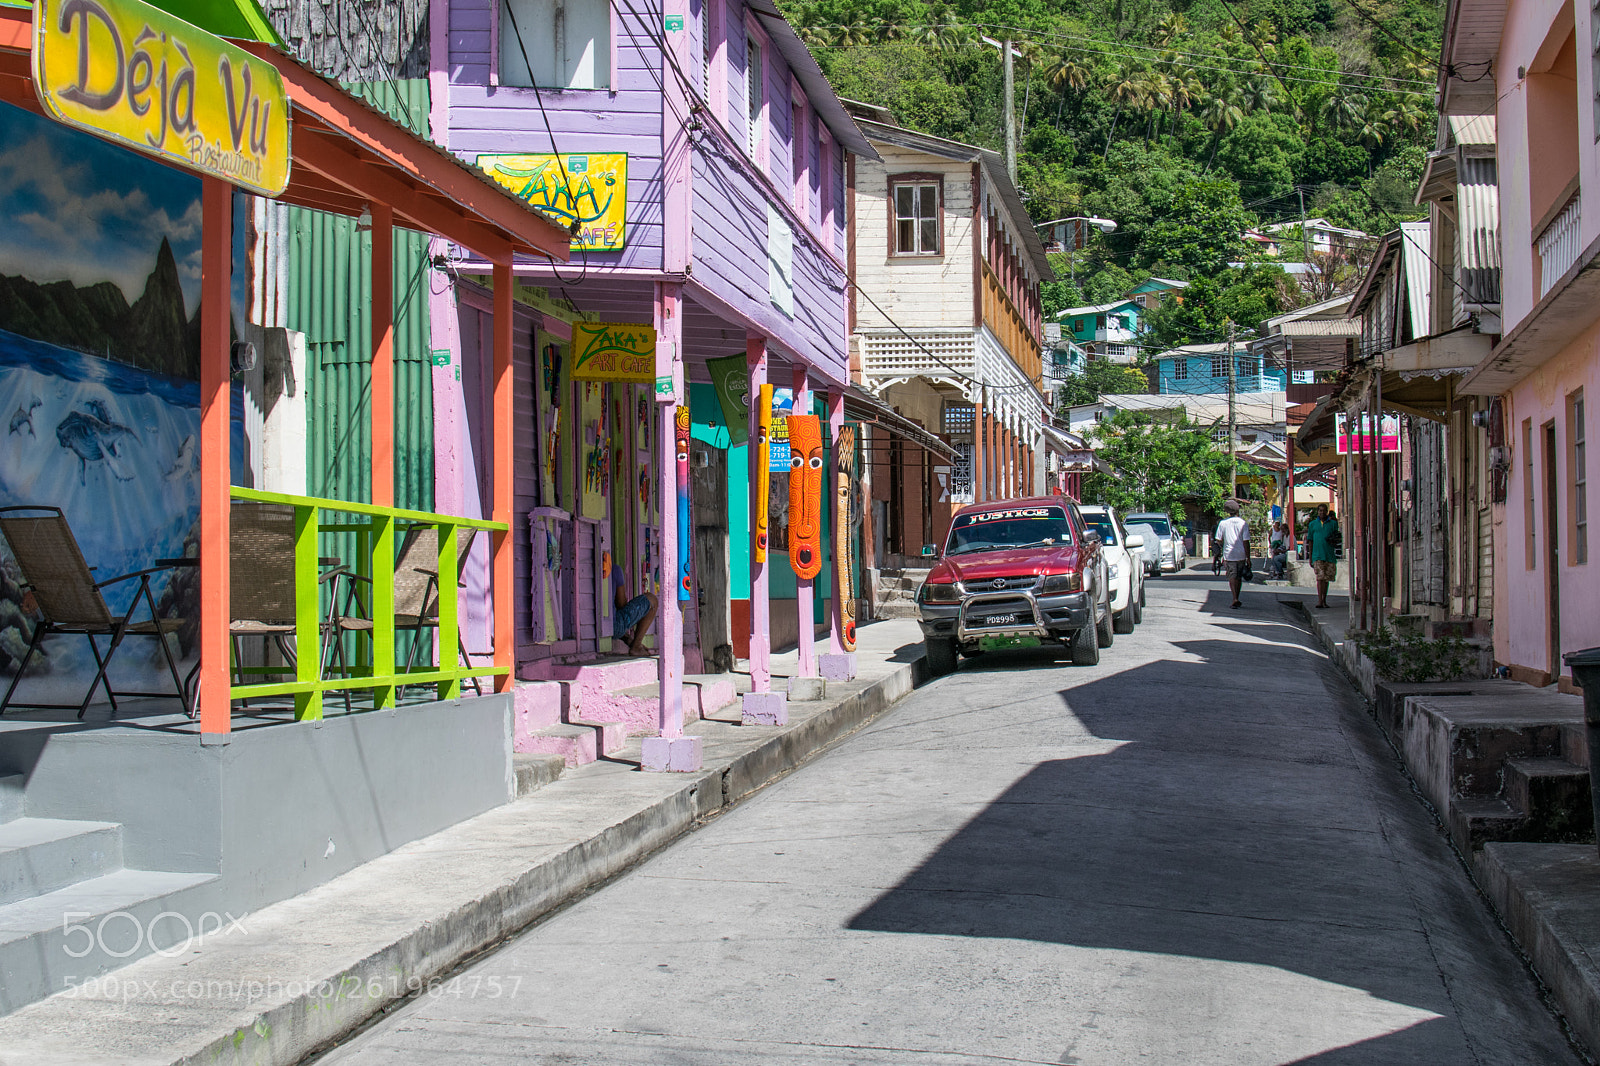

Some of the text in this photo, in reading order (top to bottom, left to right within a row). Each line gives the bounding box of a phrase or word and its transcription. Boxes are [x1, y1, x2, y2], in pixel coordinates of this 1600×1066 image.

[57, 0, 271, 156] Déjà Vu
[184, 131, 264, 183] Restaurant
[589, 353, 619, 372] ART
[969, 509, 1049, 524] JUSTICE
